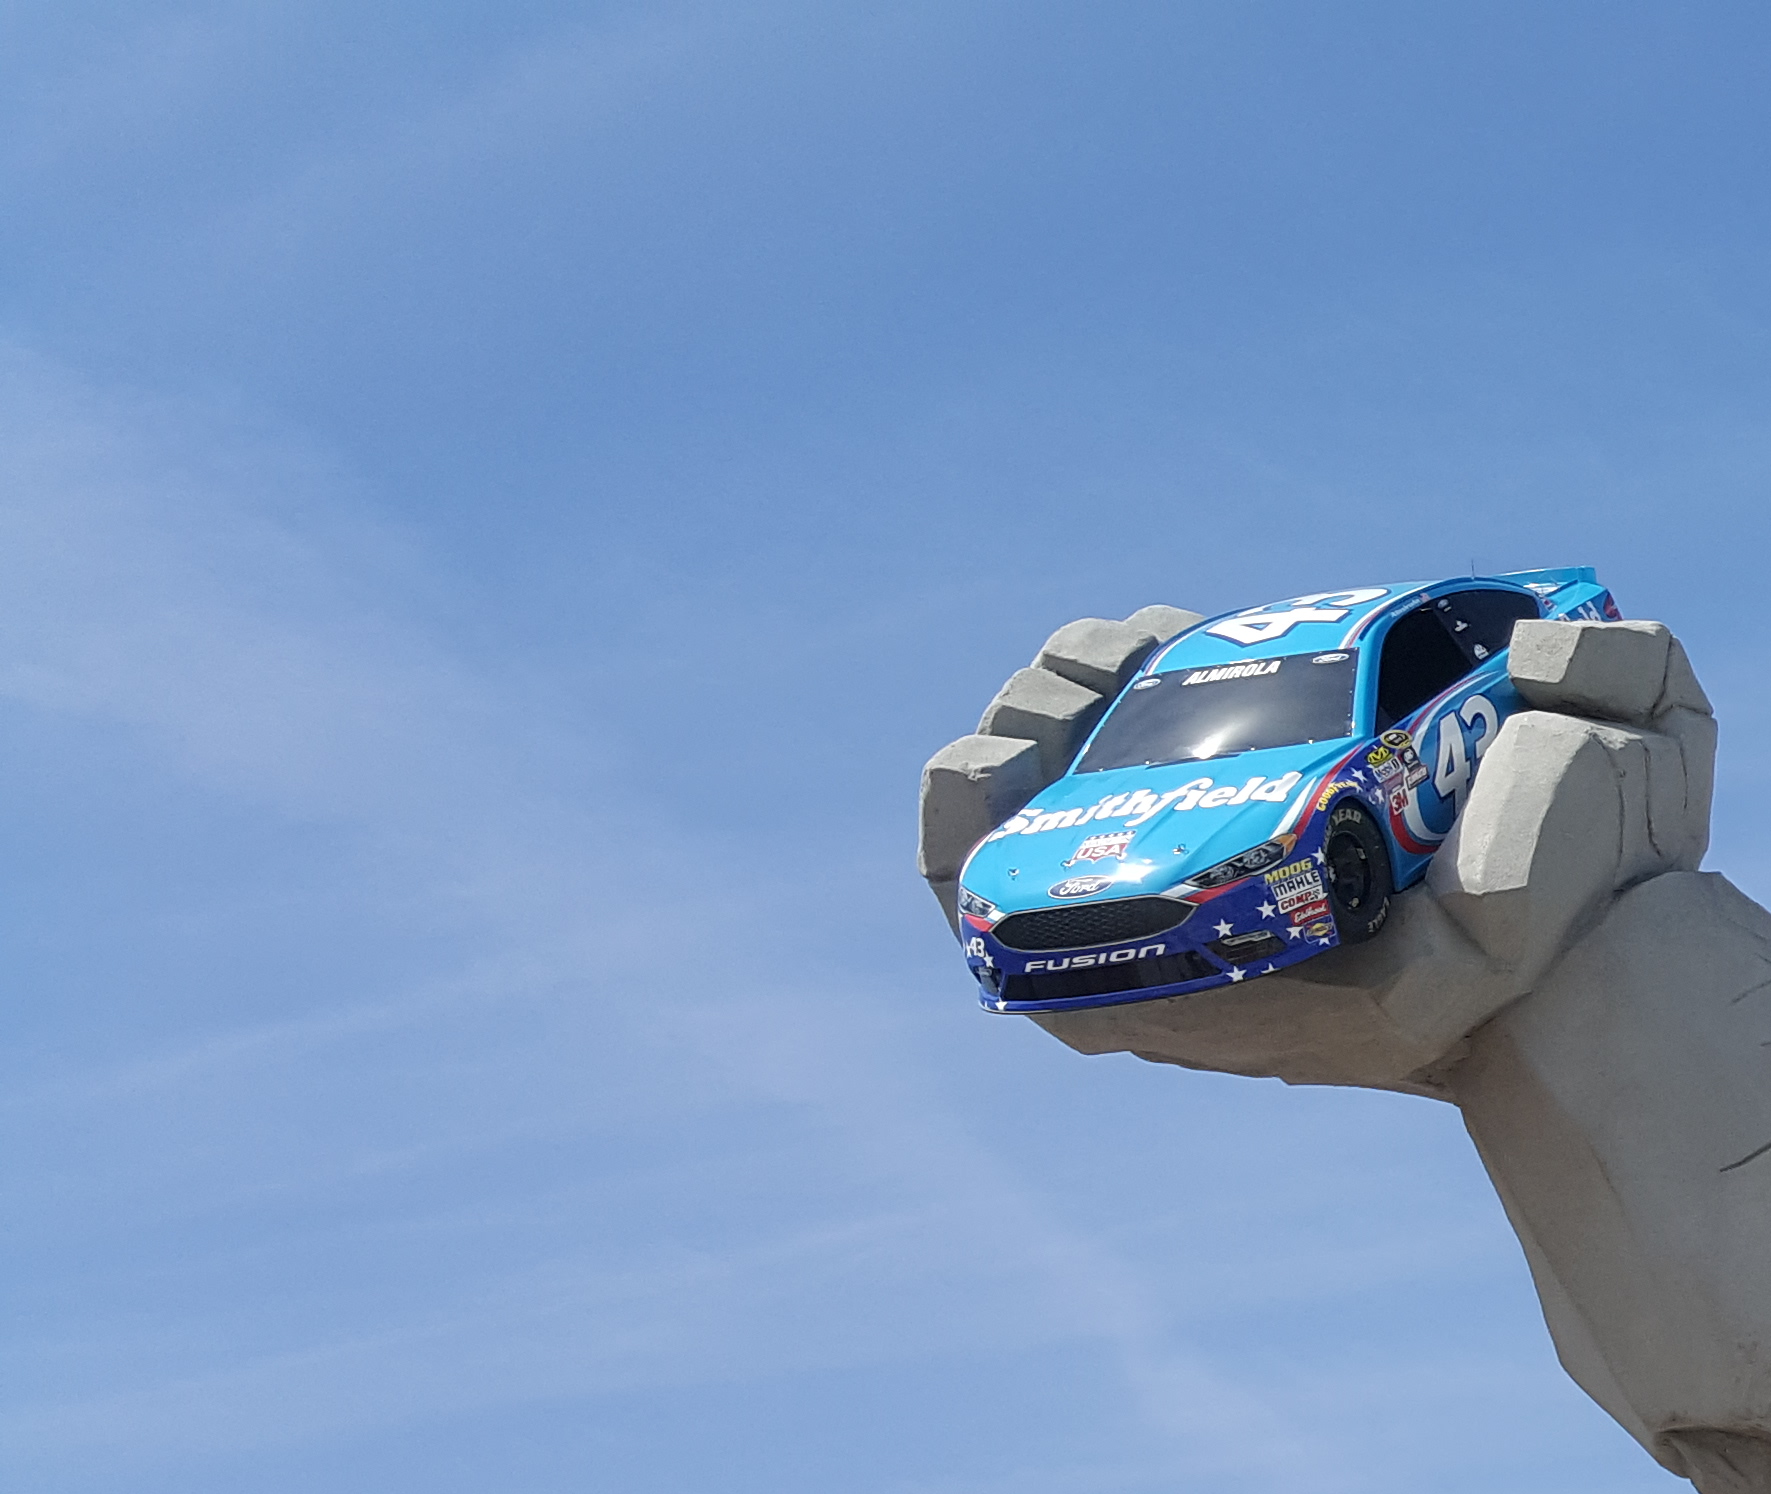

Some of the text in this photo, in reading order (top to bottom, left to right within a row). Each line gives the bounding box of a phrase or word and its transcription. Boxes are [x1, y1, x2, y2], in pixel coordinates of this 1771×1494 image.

[1206, 587, 1389, 647] 43
[1182, 660, 1282, 686] ALMIROLA
[988, 771, 1303, 841] Smithfield
[1076, 844, 1121, 859] USA
[1264, 858, 1313, 885] MOOG
[1273, 869, 1320, 897] MAHLE
[1058, 878, 1102, 896] Ford
[969, 936, 985, 957] 43
[1024, 943, 1167, 973] FUSION
